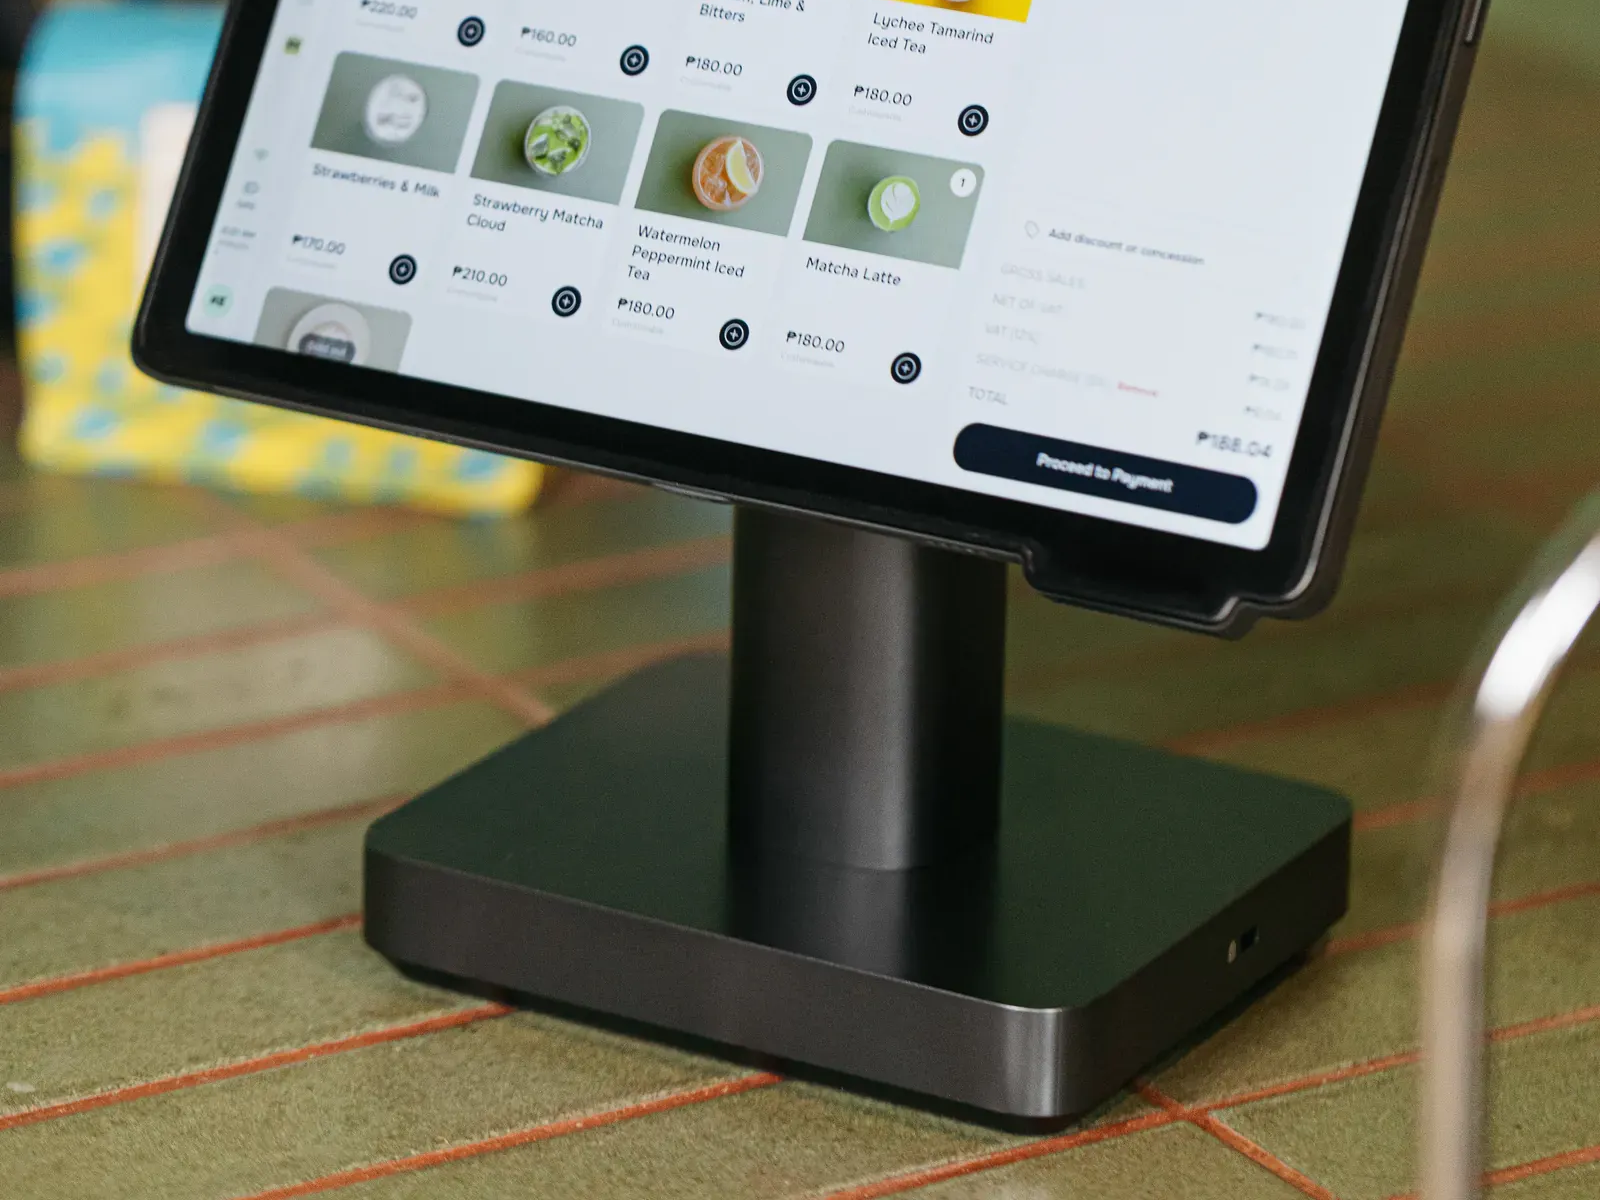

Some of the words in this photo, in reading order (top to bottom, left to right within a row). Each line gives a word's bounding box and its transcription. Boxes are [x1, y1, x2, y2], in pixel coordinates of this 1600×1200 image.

[700, 3, 745, 22] Bitters
[873, 12, 925, 34] Lychee
[930, 20, 994, 44] Tamarind
[868, 32, 898, 50] Iced
[903, 38, 926, 54] Tea
[313, 162, 396, 191] Strawberries
[400, 178, 409, 193] &
[414, 182, 440, 198] Milk
[466, 213, 506, 232] Cloud
[473, 193, 549, 222] Strawberry
[552, 208, 604, 230] Matcha
[638, 224, 721, 252] Watermelon
[1049, 228, 1071, 243] Add
[1075, 233, 1123, 252] discount
[1126, 243, 1137, 255] or
[627, 265, 650, 282] Tea
[631, 245, 711, 273] Peppermint
[715, 259, 745, 279] Iced
[805, 256, 859, 278] Matcha
[863, 266, 901, 286] Latte
[968, 385, 1008, 406] TOTAL
[1035, 451, 1093, 479] Proceed
[1095, 464, 1111, 480] to
[1112, 467, 1174, 494] Payment
